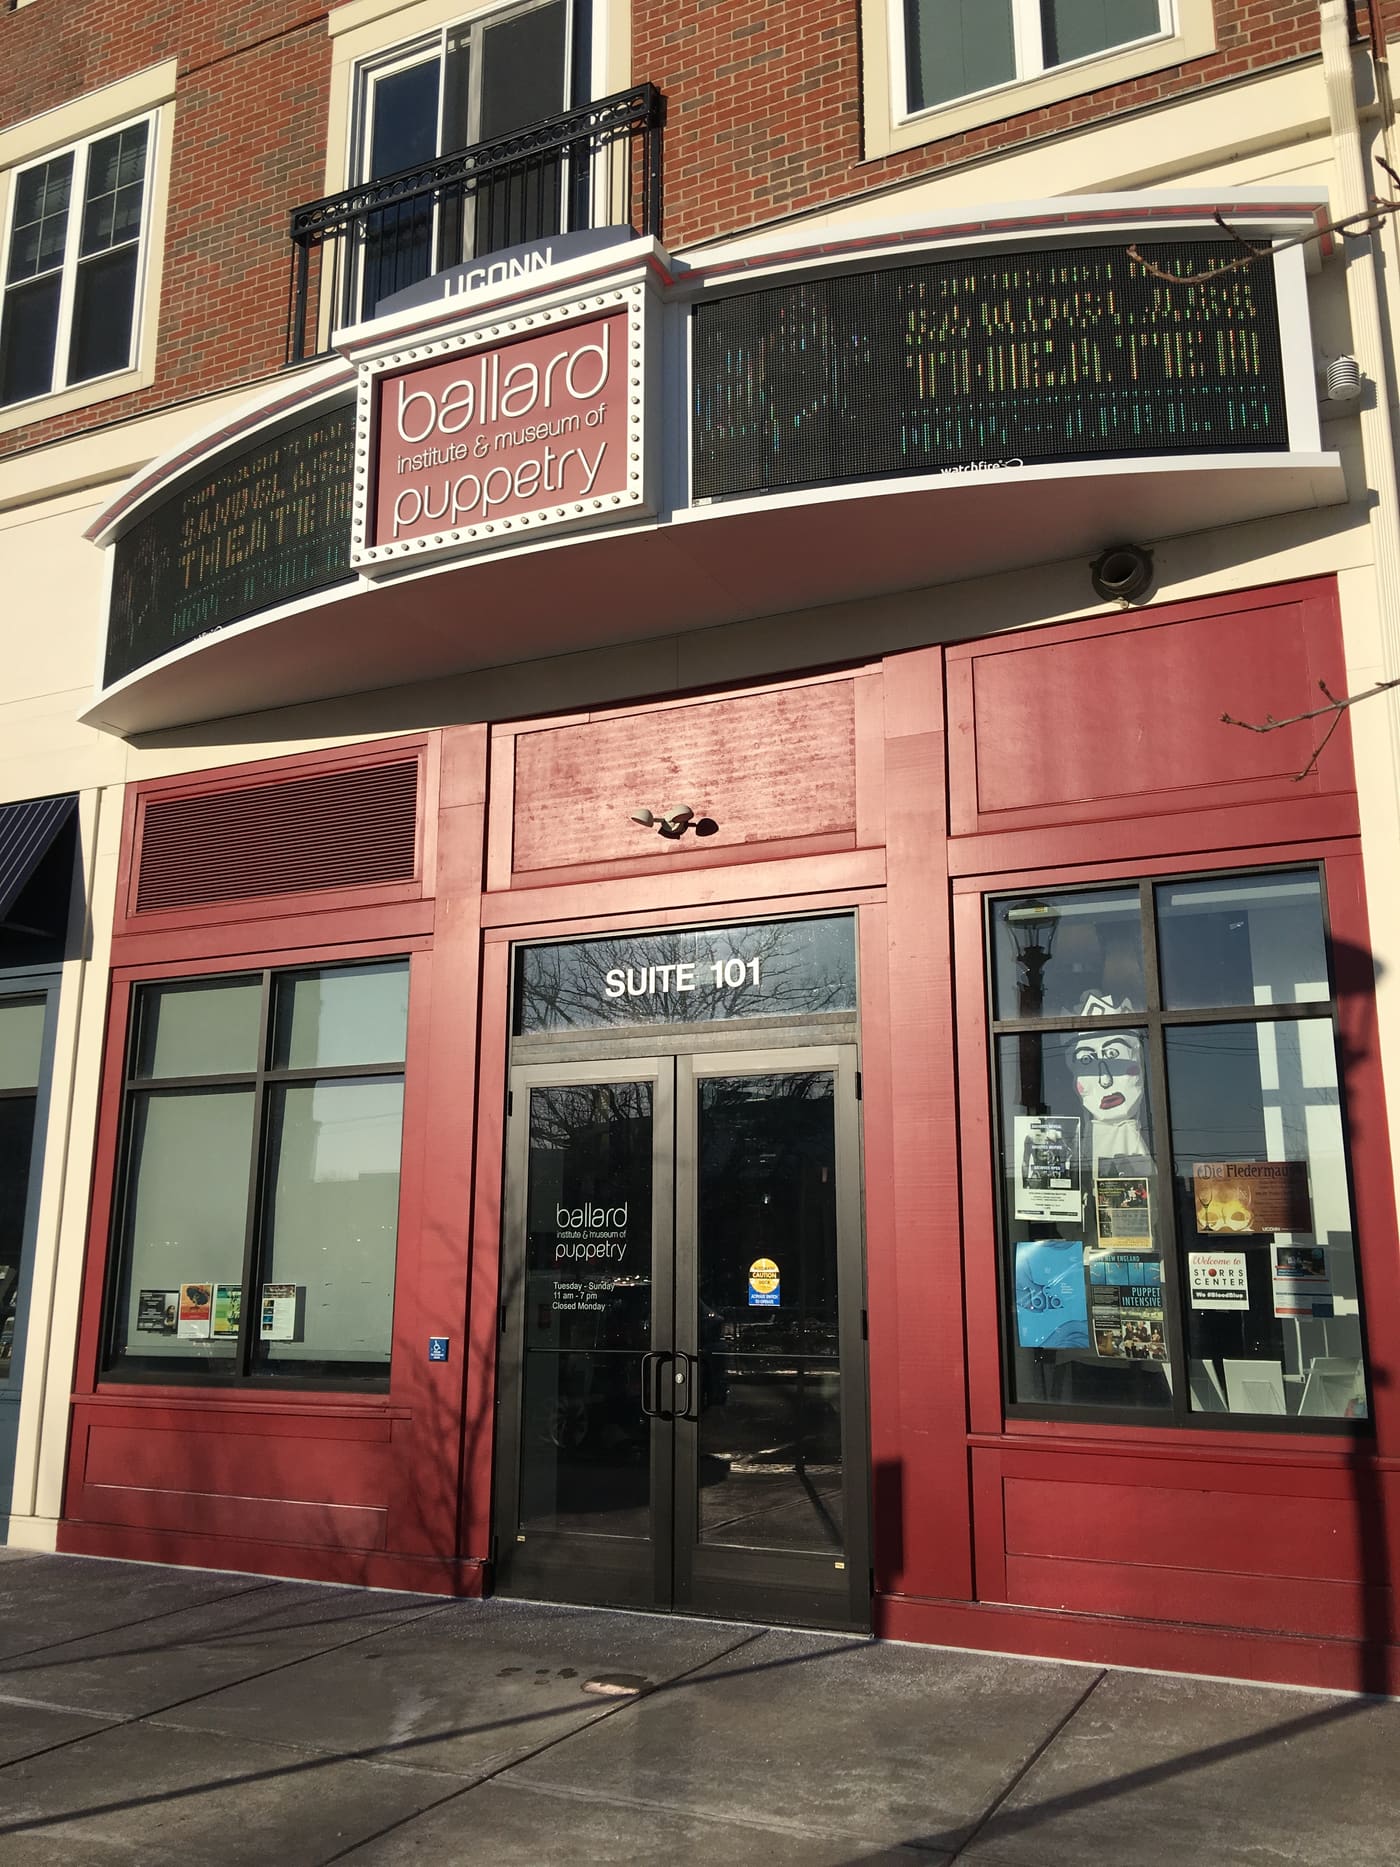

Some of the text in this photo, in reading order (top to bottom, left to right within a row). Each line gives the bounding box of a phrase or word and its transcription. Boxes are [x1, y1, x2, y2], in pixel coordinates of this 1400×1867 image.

[445, 246, 552, 299] UCONN
[397, 323, 610, 443] ballard
[397, 402, 607, 475] institute & museum of
[940, 460, 1001, 474] watchfire
[393, 442, 608, 537] puppetry
[605, 957, 760, 998] SUITE 101
[1198, 1163, 1293, 1180] Die Fledermau
[556, 1201, 628, 1228] ballard
[589, 1230, 619, 1239] museum
[555, 1240, 627, 1262] puppetry
[1193, 1255, 1241, 1265] Welcome to
[752, 1271, 777, 1279] CAUTION
[1193, 1268, 1244, 1277] STORRS
[553, 1281, 583, 1291] Tuesday
[588, 1281, 616, 1292] Sunday
[1194, 1277, 1244, 1286] CENTER
[553, 1291, 561, 1299] 11
[580, 1291, 585, 1299] 7
[586, 1293, 598, 1301] pm
[1131, 1287, 1161, 1297] PUPPET
[552, 1301, 606, 1312] Closed Monday
[1122, 1297, 1161, 1307] INTENSIVE
